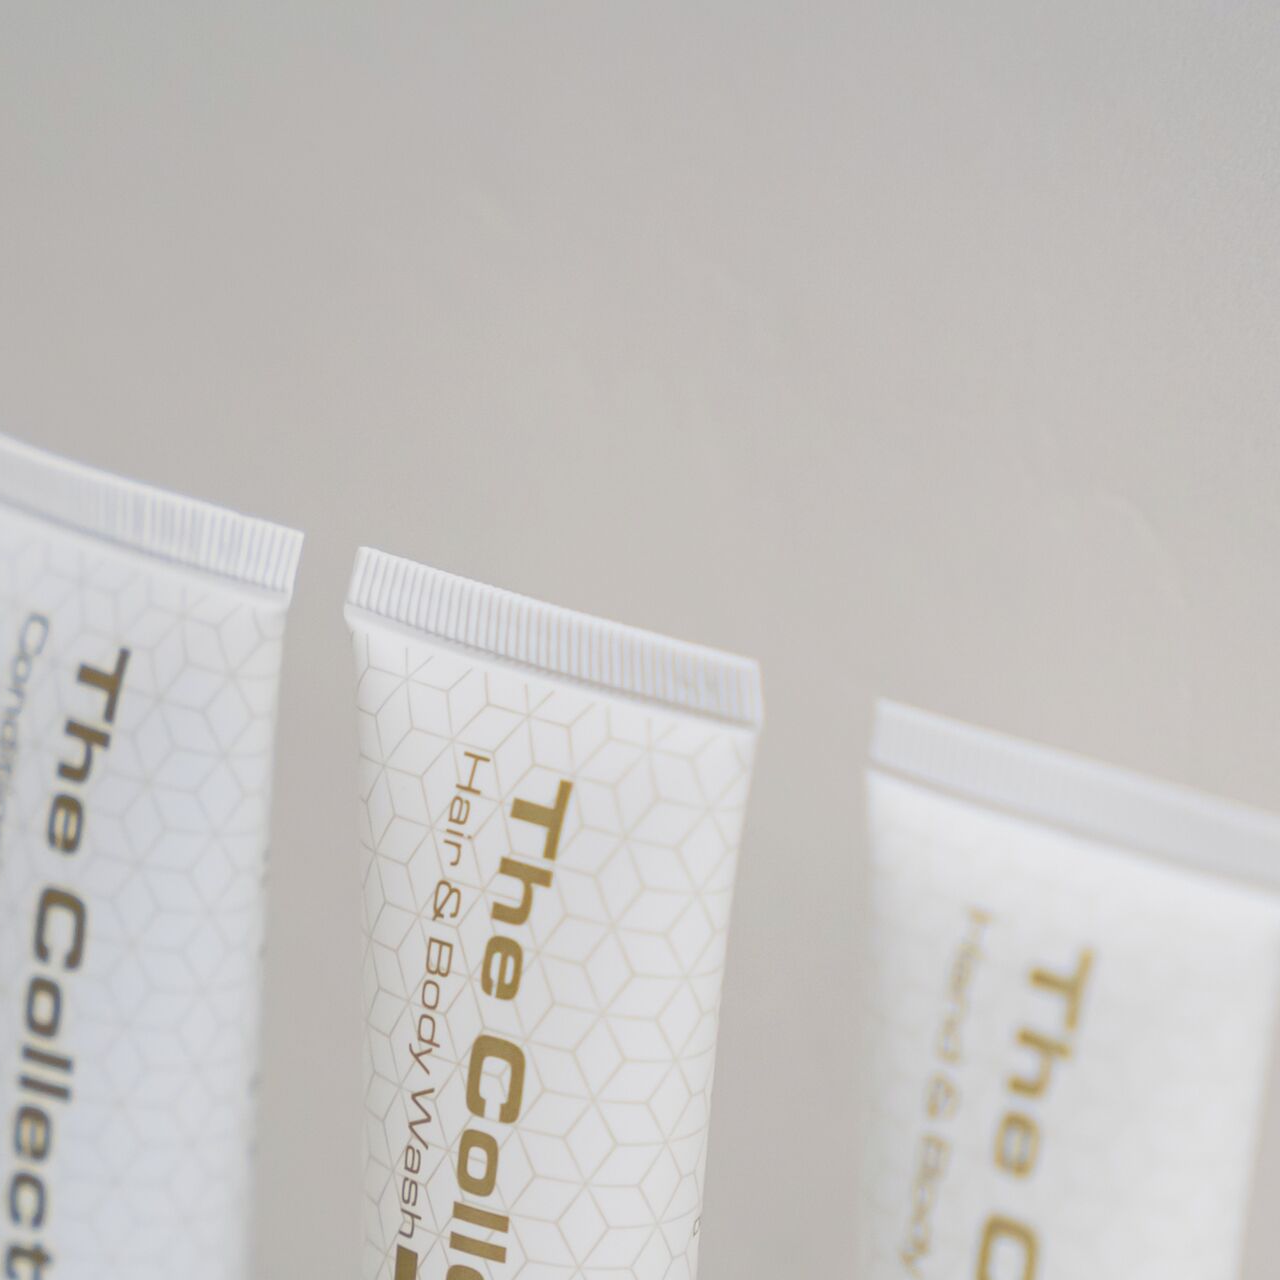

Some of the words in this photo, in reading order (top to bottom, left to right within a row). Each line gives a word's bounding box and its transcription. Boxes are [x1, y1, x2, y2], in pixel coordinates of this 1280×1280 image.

[47, 648, 131, 857] The
[443, 749, 491, 868] Hair
[432, 878, 462, 923] &
[481, 779, 574, 1002] The
[407, 938, 454, 1076] Body
[993, 947, 1094, 1180] The
[398, 1085, 436, 1240] Wash
[900, 1132, 953, 1279] Body
